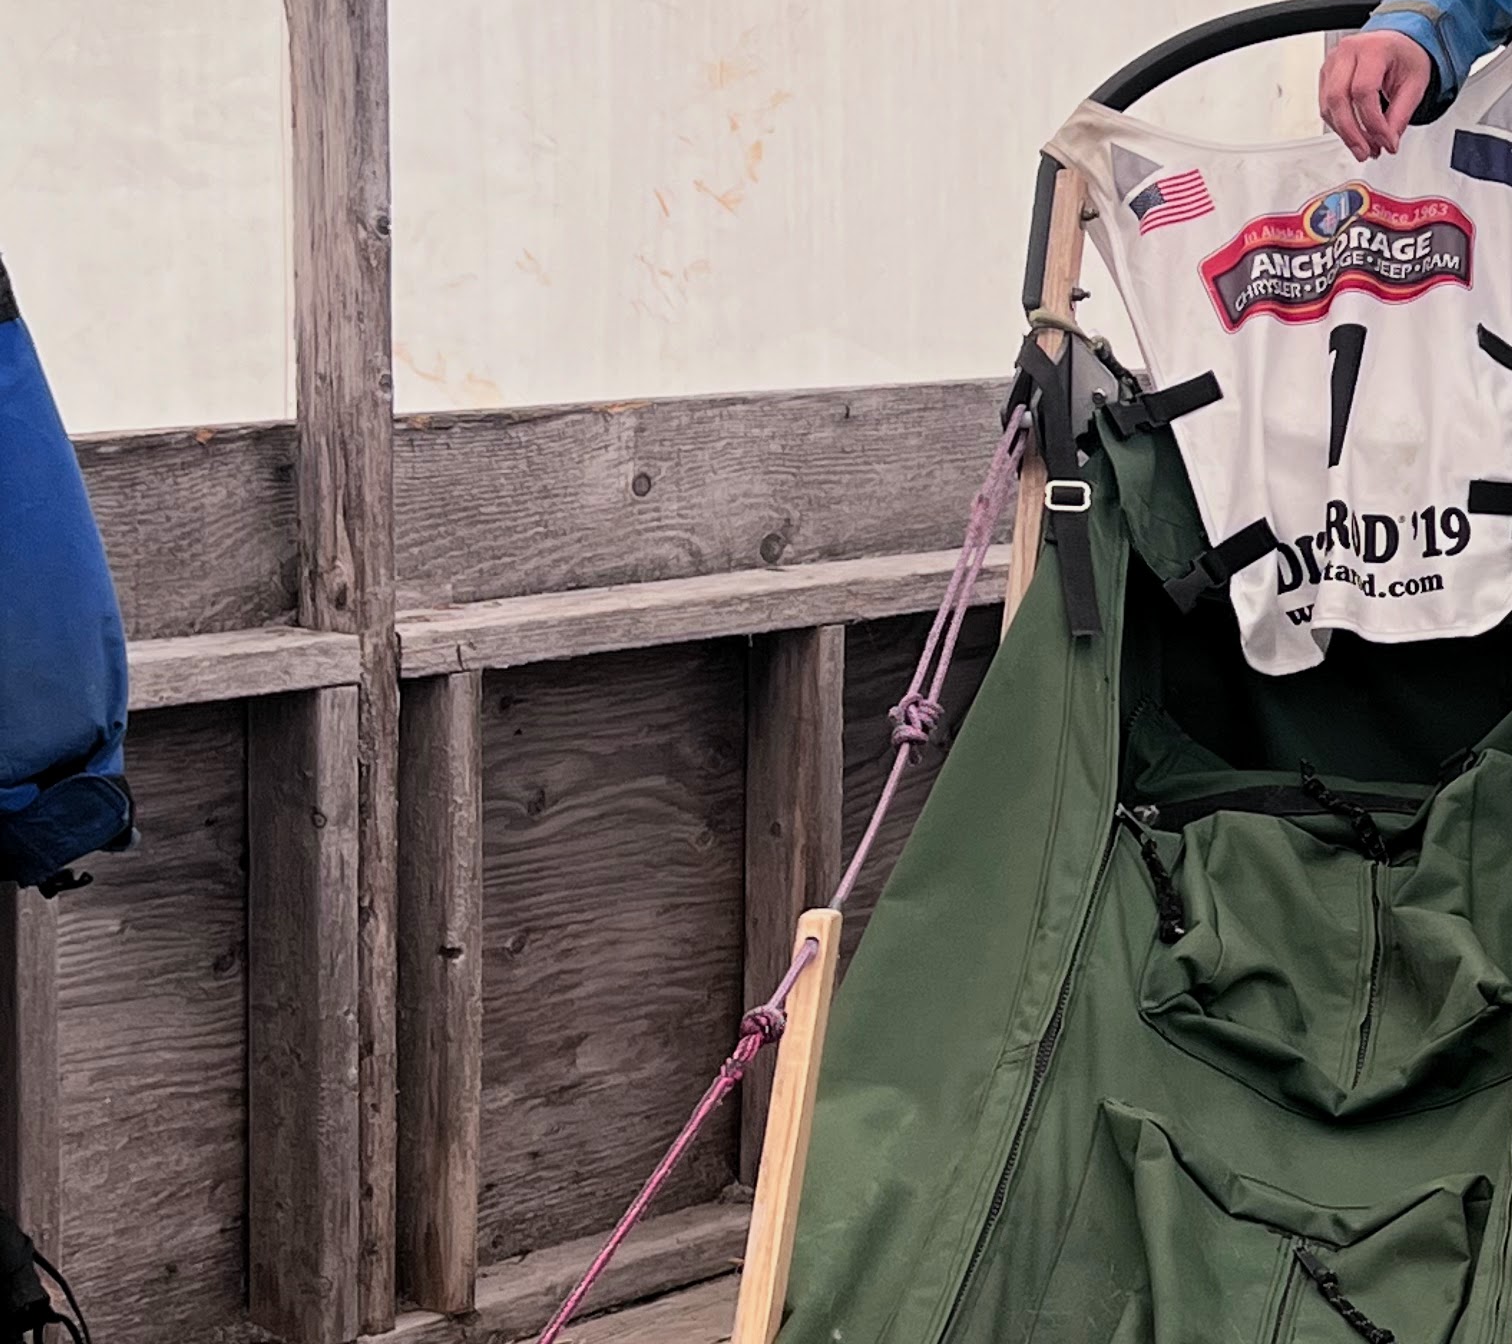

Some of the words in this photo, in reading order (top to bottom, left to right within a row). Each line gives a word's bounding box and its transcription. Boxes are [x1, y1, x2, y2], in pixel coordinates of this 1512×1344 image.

[1372, 203, 1410, 223] Since
[1250, 226, 1433, 281] ANCHORAGE
[1235, 278, 1302, 312] CHRYSLER
[1374, 258, 1412, 279] JEEP
[1422, 253, 1460, 273] RAM
[1412, 506, 1471, 558] '19
